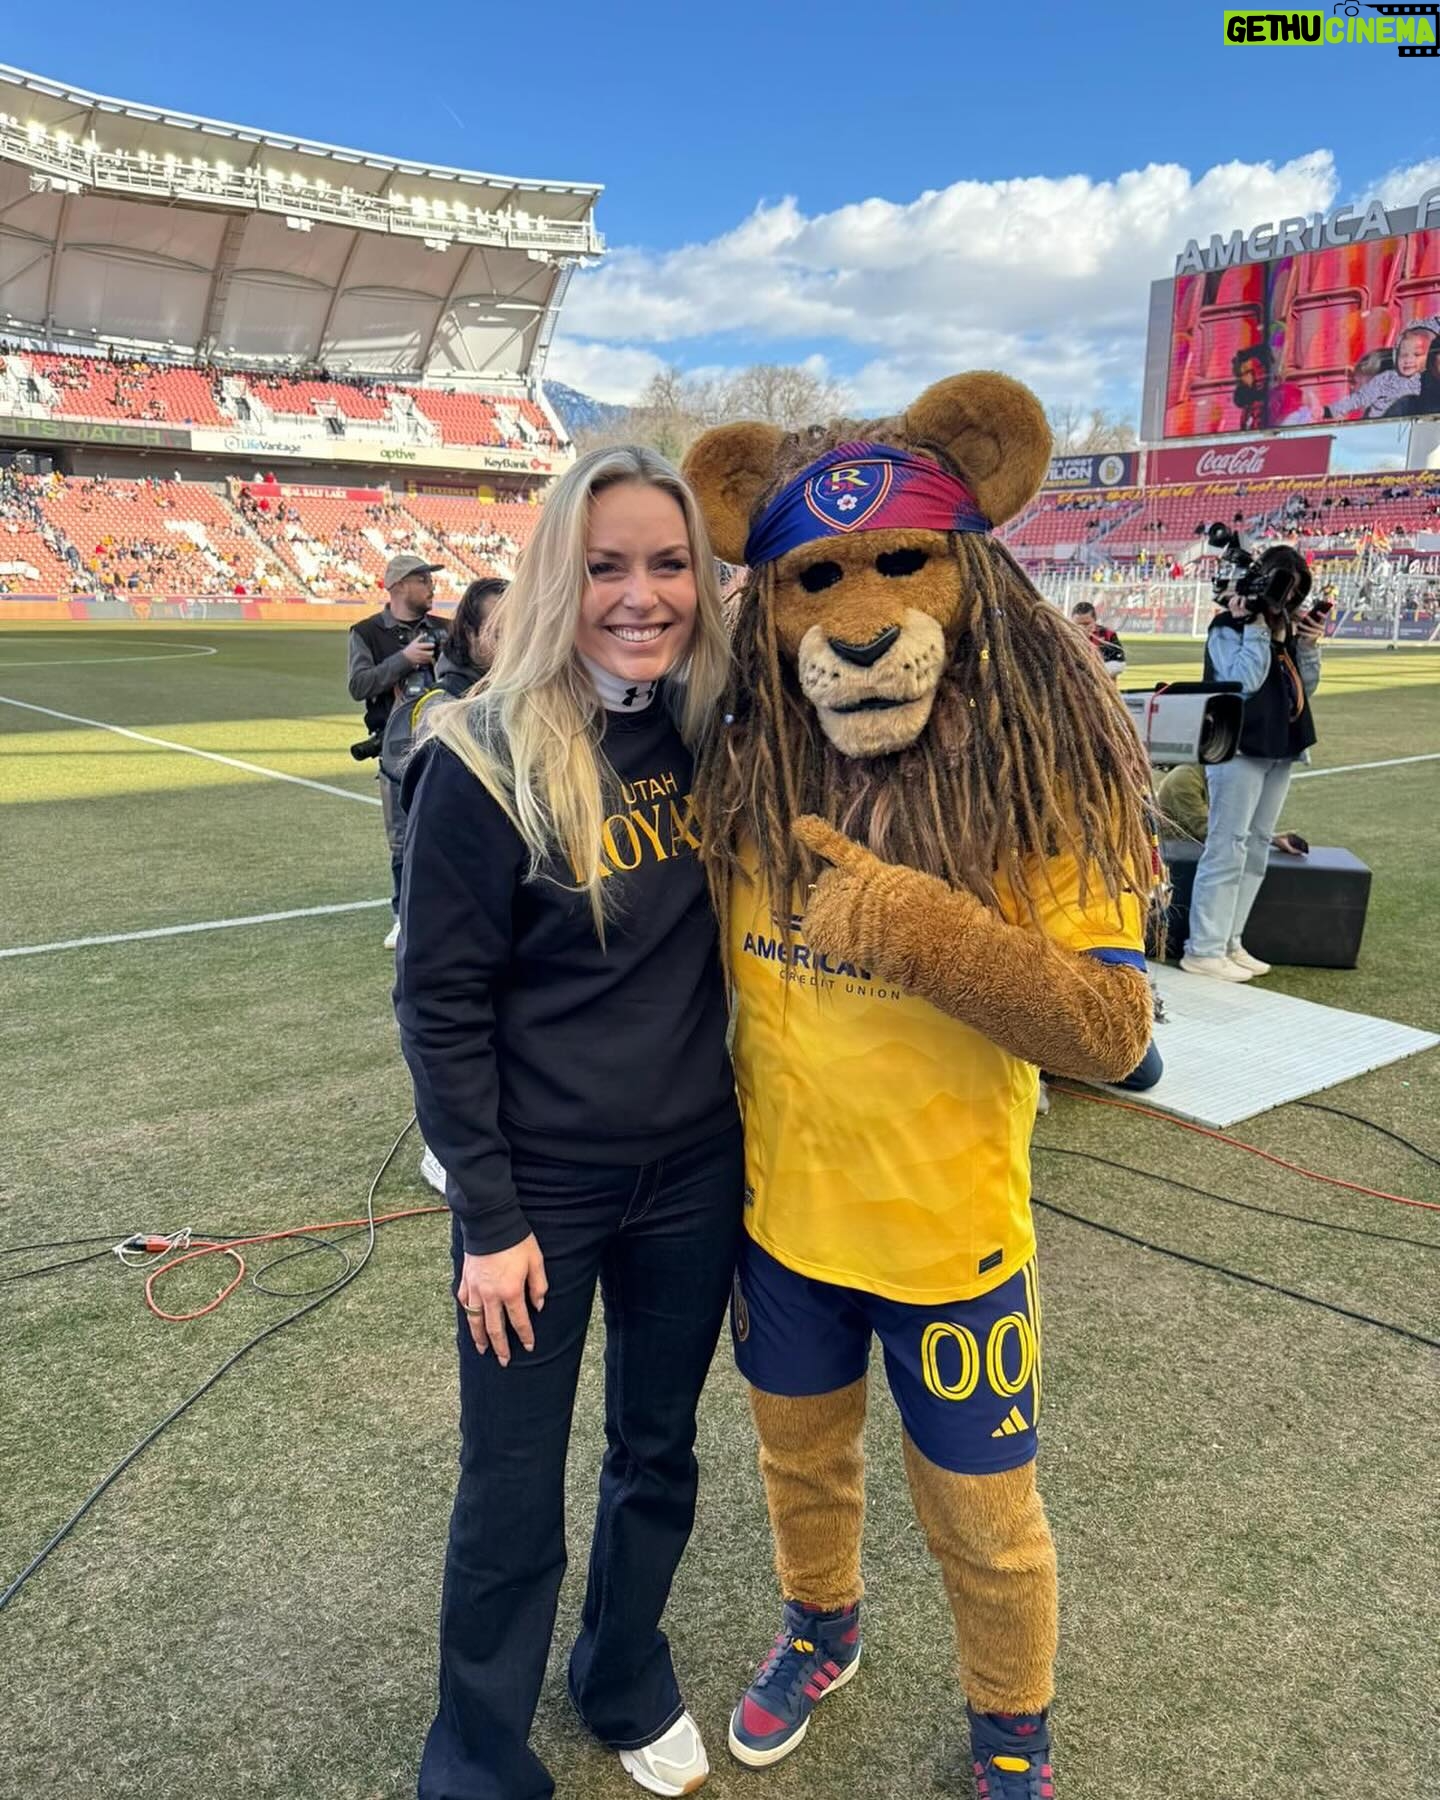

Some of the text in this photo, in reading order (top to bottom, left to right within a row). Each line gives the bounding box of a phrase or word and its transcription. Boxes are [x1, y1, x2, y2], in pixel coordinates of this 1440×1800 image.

[1177, 200, 1391, 274] AMERICA
[63, 424, 161, 445] MATCH
[241, 439, 301, 454] LifeVantage
[380, 449, 416, 461] optive
[484, 457, 529, 470] KeyBank
[1196, 446, 1270, 477] Coca-Cola
[620, 771, 679, 805] UTAH
[779, 968, 836, 989] CREDIT
[845, 983, 900, 1000] UNION
[920, 1311, 1035, 1402] 00
